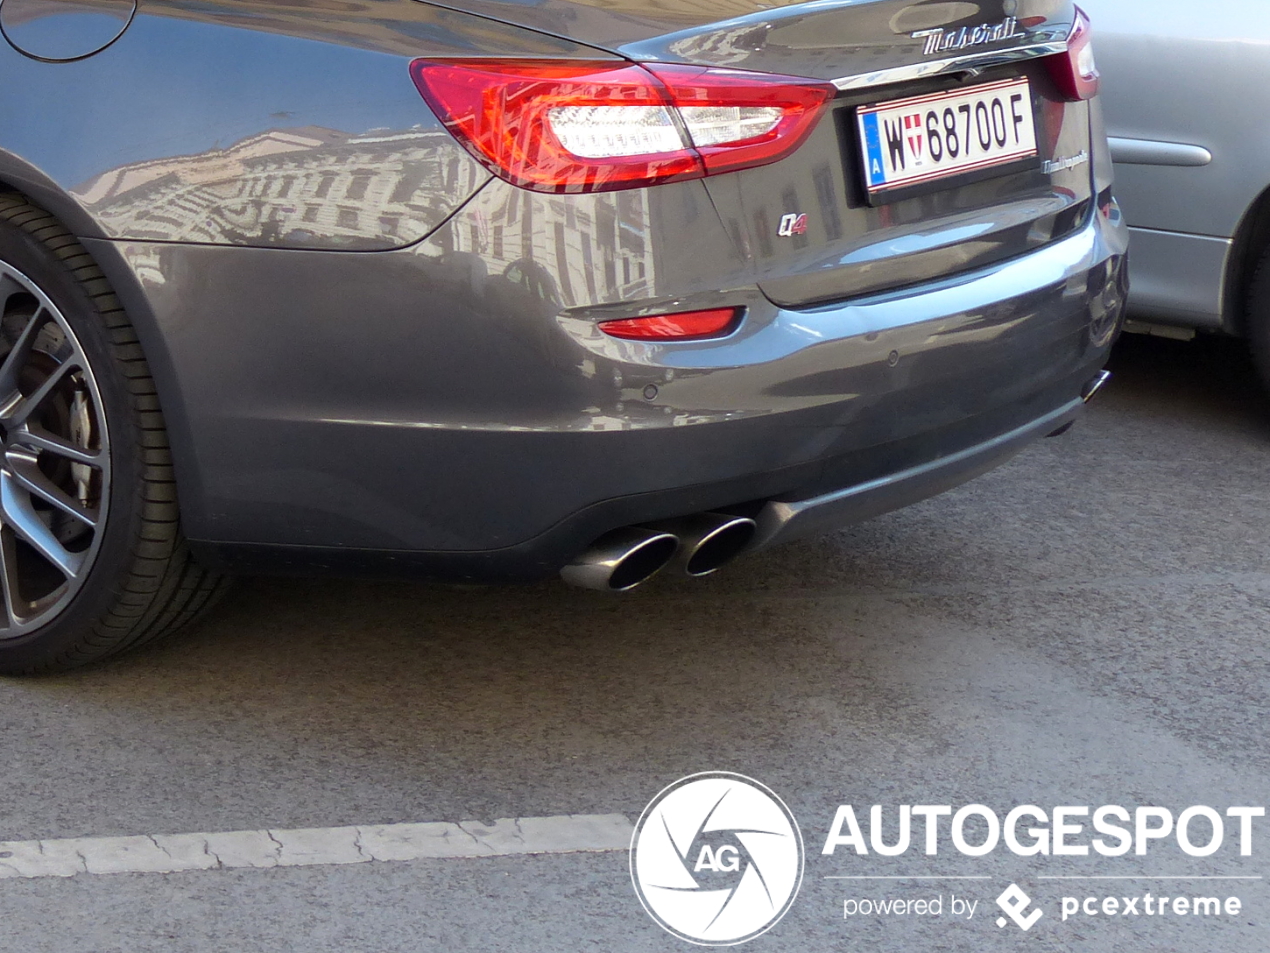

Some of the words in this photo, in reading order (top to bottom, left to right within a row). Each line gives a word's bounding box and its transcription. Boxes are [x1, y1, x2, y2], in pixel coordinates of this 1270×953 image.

[911, 15, 1025, 55] Maserati
[872, 158, 880, 174] A
[884, 116, 905, 172] W
[925, 97, 1007, 162] 68700
[1010, 93, 1024, 146] F
[778, 213, 808, 236] Q4
